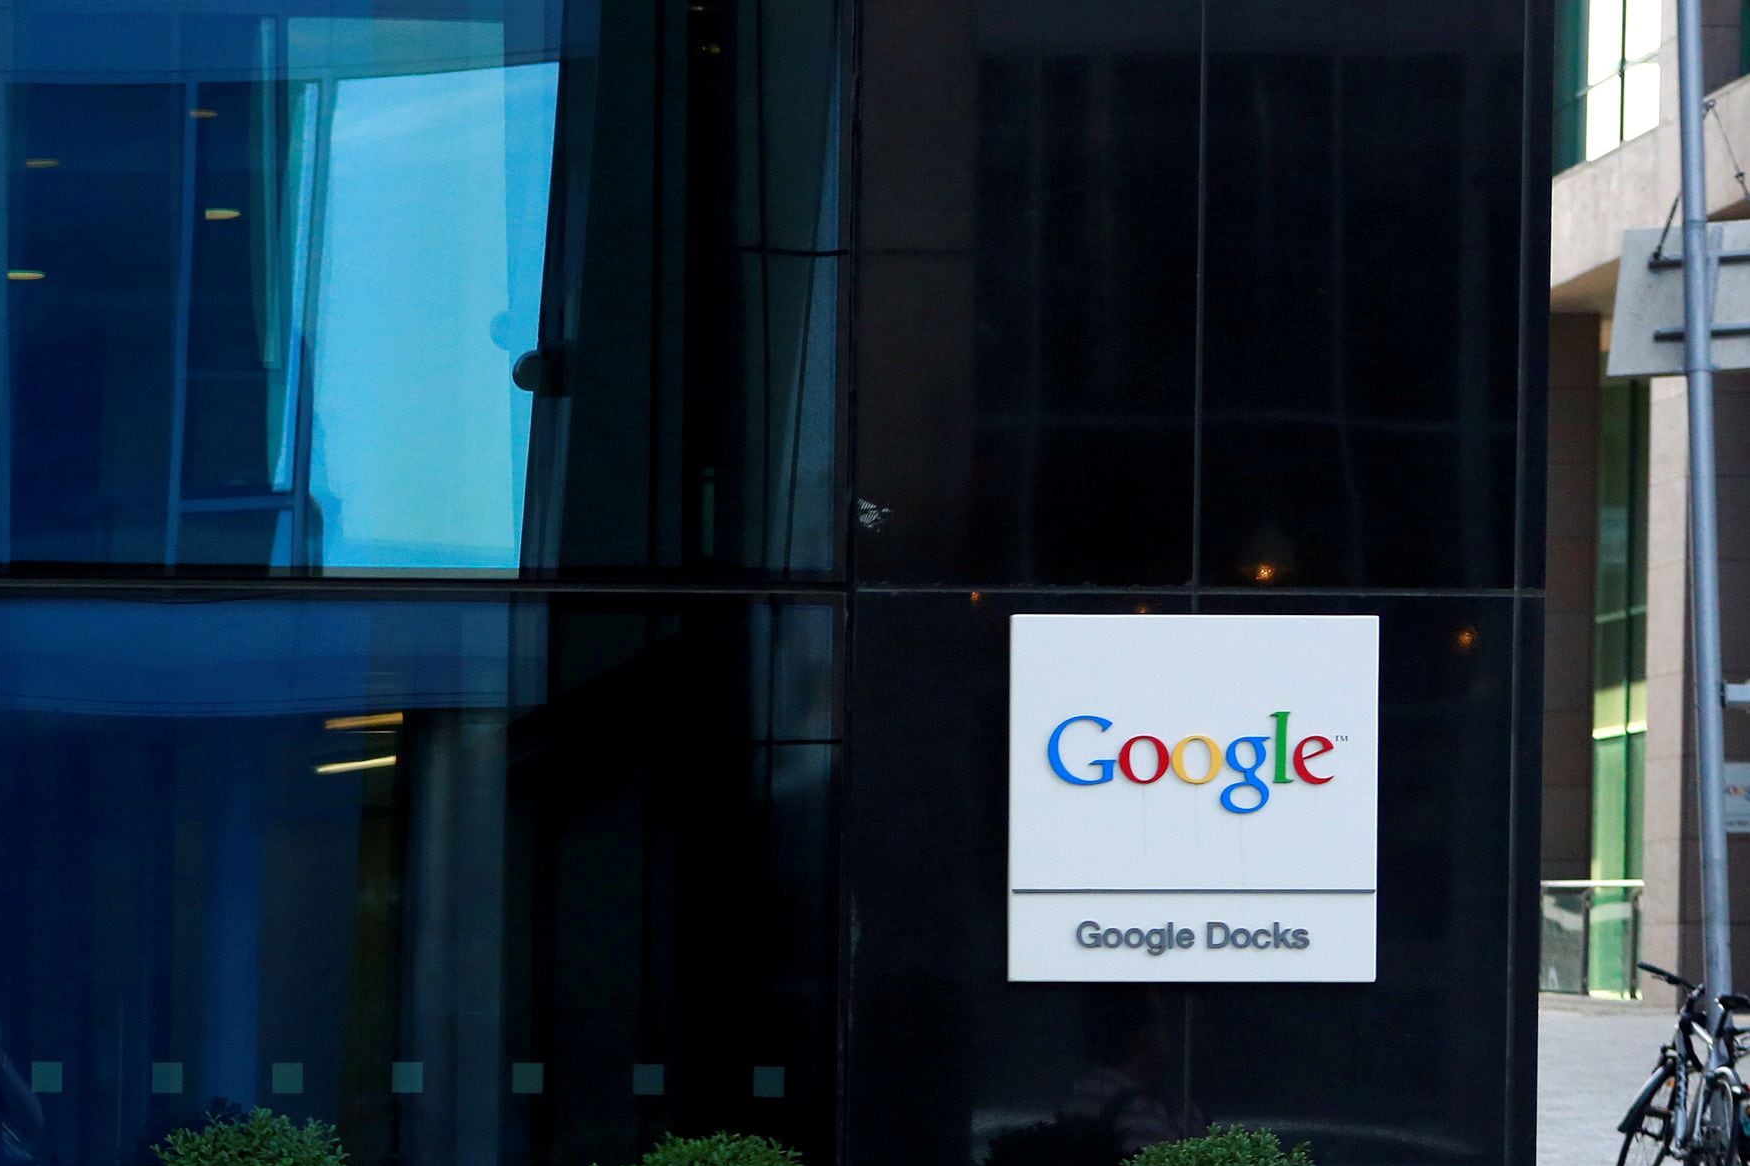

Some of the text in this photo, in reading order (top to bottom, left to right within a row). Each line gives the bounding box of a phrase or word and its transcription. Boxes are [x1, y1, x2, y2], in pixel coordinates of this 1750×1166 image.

[1047, 711, 1335, 814] Google
[1076, 920, 1310, 956] Google Docks
